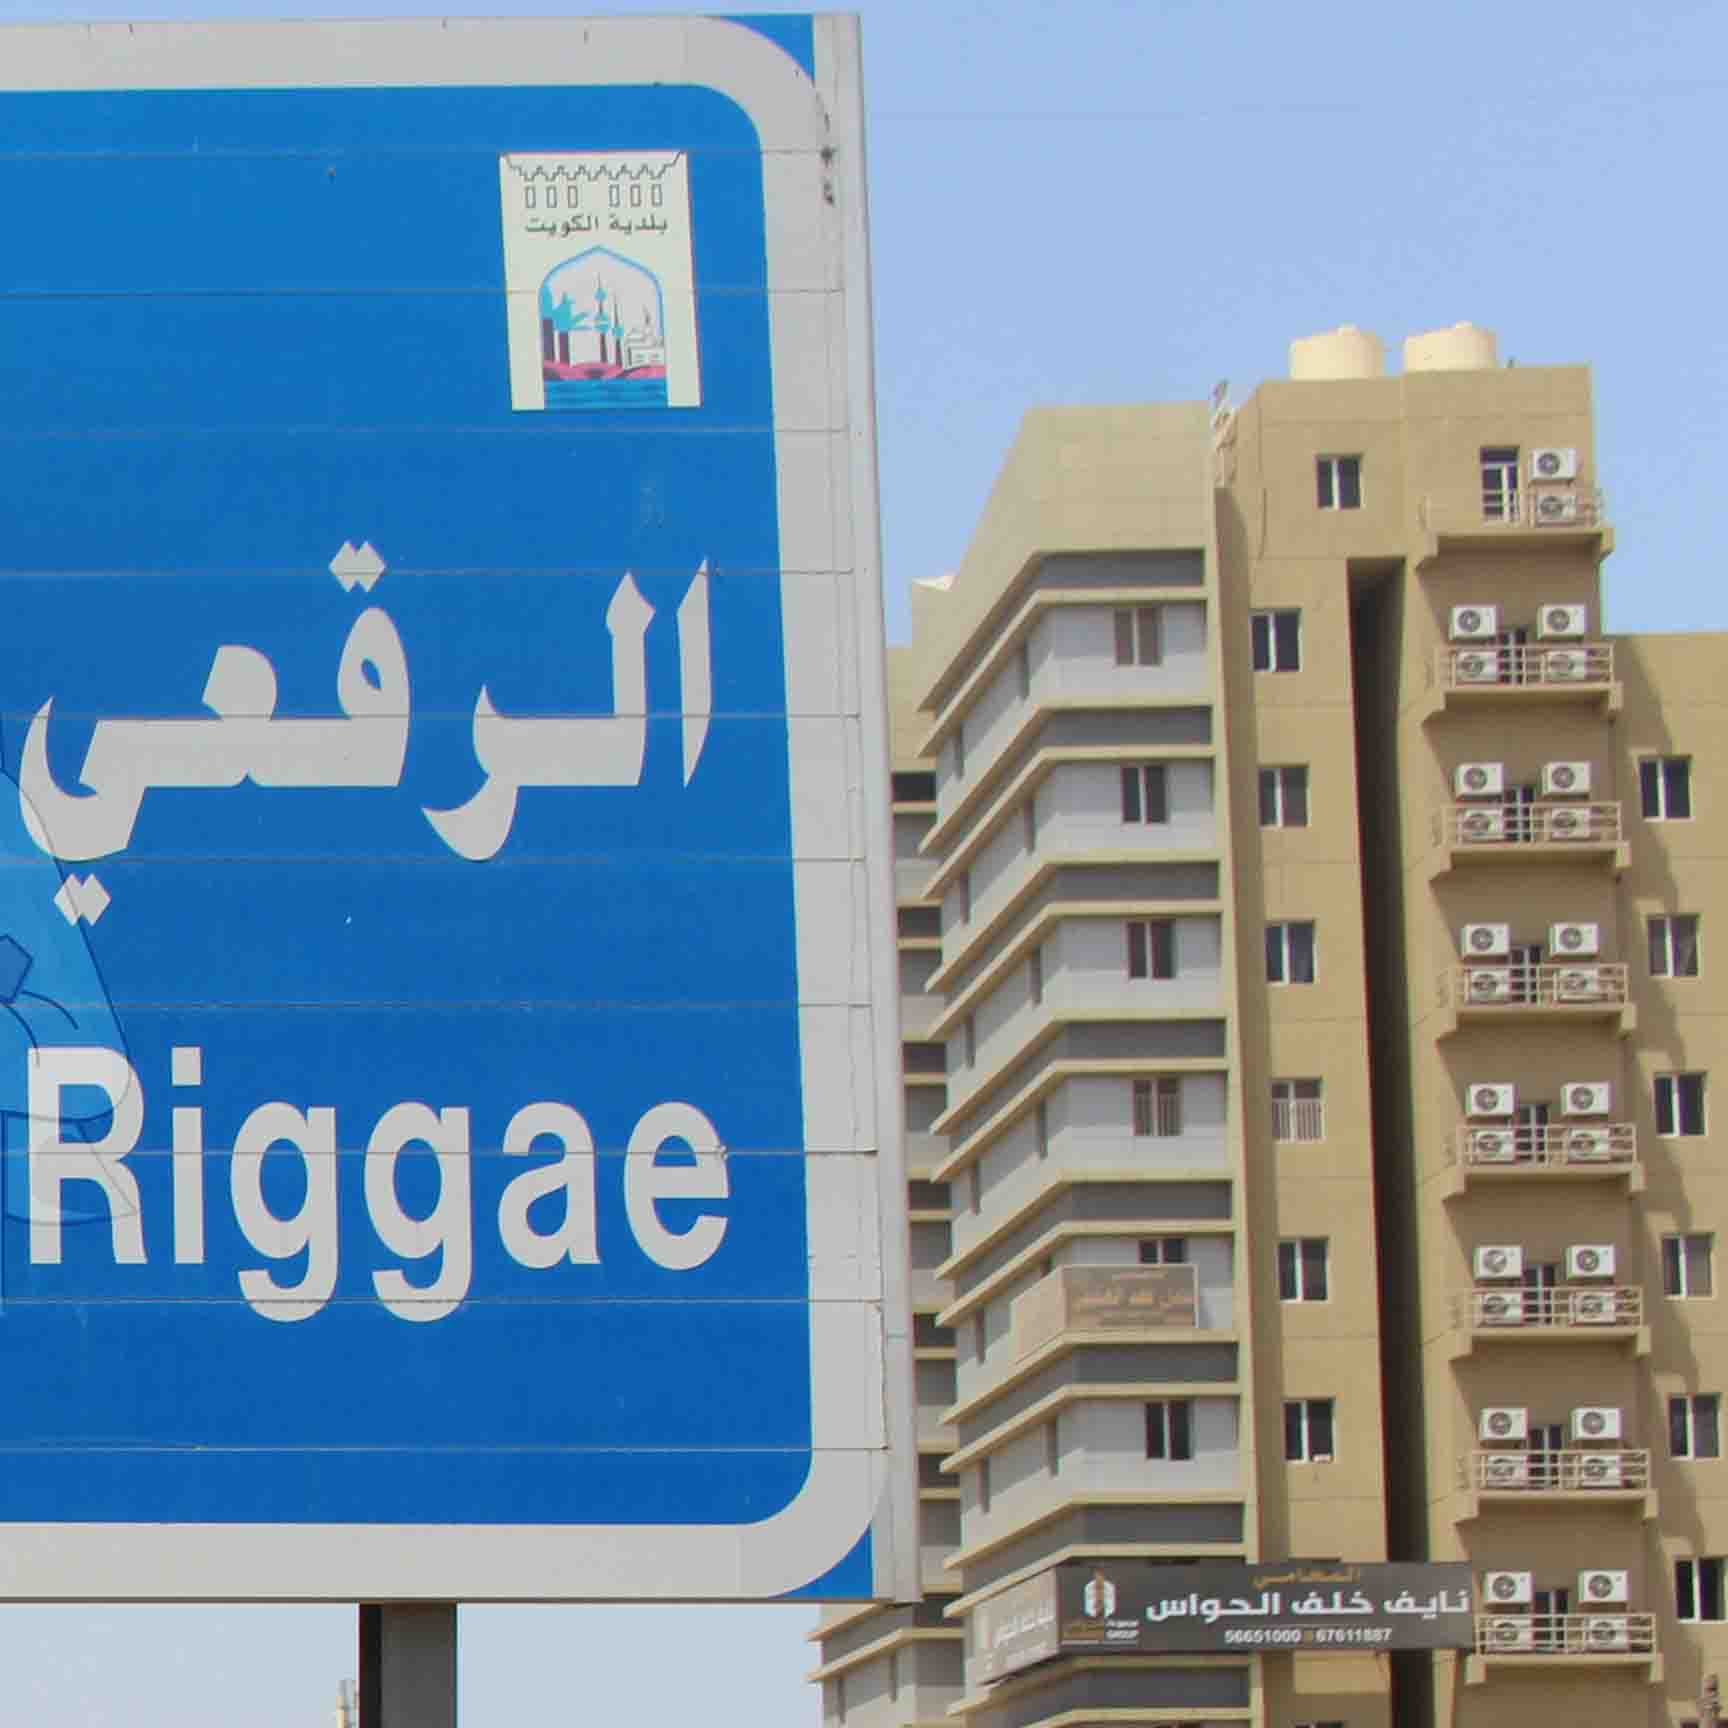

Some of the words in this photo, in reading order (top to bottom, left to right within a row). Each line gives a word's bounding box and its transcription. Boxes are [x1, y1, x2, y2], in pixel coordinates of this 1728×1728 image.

[525, 213, 600, 238] الكويت
[609, 212, 668, 235] بلدية
[18, 540, 713, 927] الرقعي
[27, 1046, 730, 1322] Riggae
[1145, 1590, 1282, 1623] الحواس
[1291, 1589, 1374, 1615] خلف
[1383, 1589, 1470, 1619] نايف
